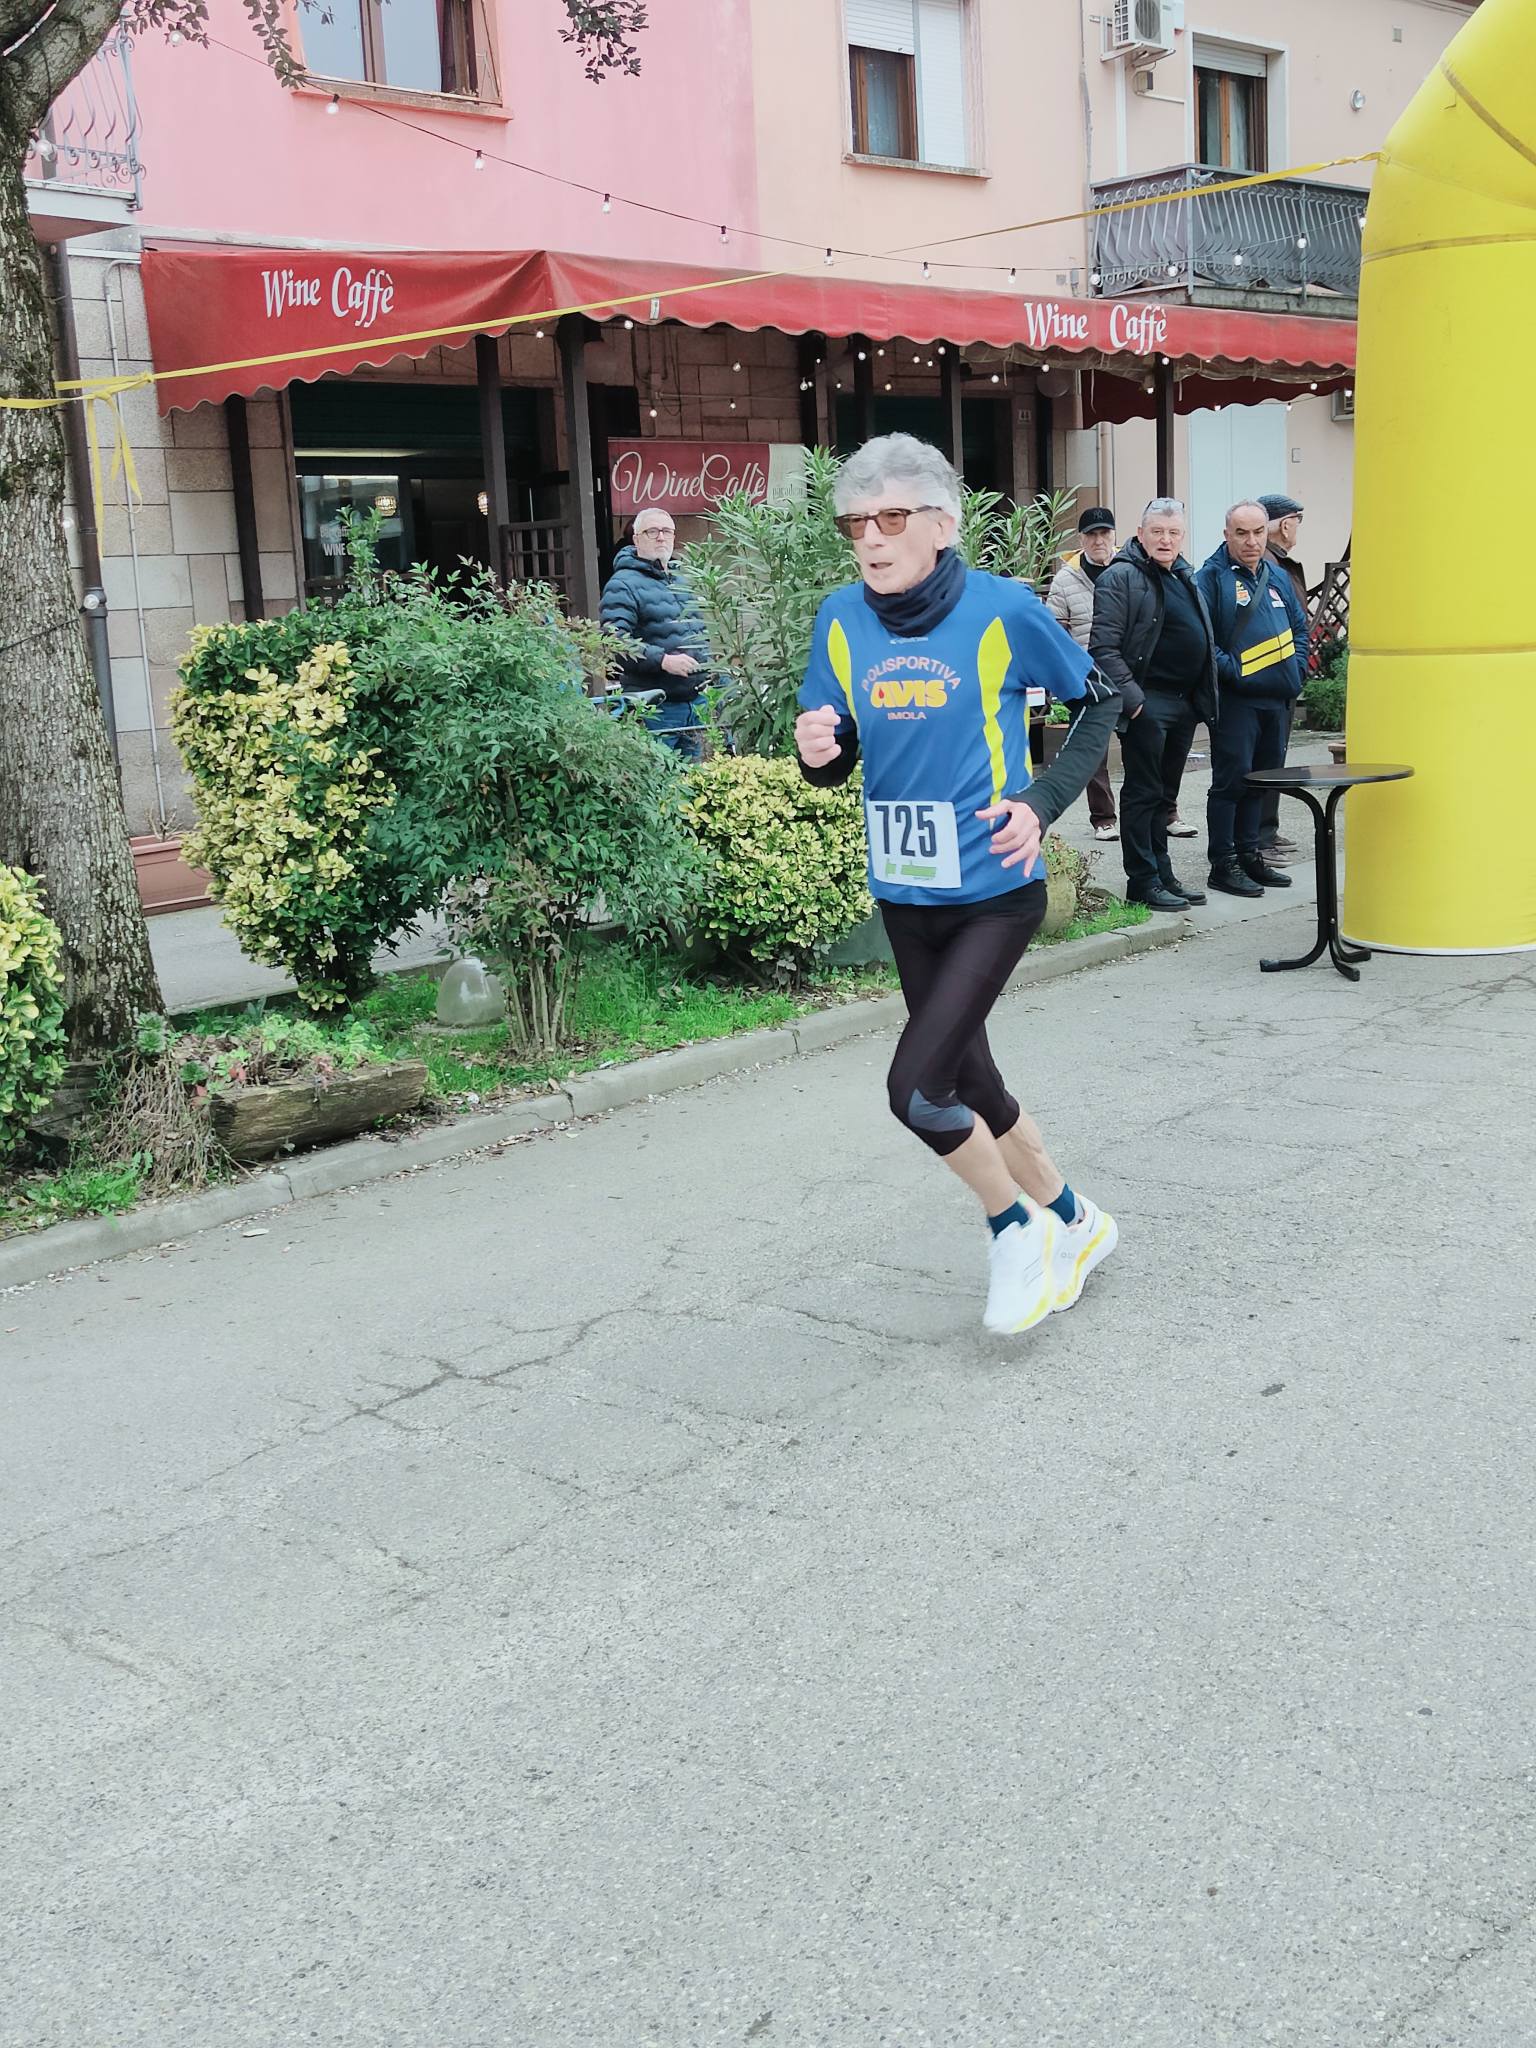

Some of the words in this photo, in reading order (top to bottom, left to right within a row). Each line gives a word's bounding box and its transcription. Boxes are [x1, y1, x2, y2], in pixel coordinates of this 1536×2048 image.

[261, 269, 322, 318] Wine
[331, 267, 394, 328] Caffè
[1024, 302, 1089, 347] Wine
[1110, 304, 1168, 356] Caffè
[323, 543, 347, 556] WINE
[861, 656, 961, 692] POLISPORTIVA
[870, 680, 948, 708] AVIS
[887, 711, 927, 721] IMOLA
[875, 805, 937, 857] 725
